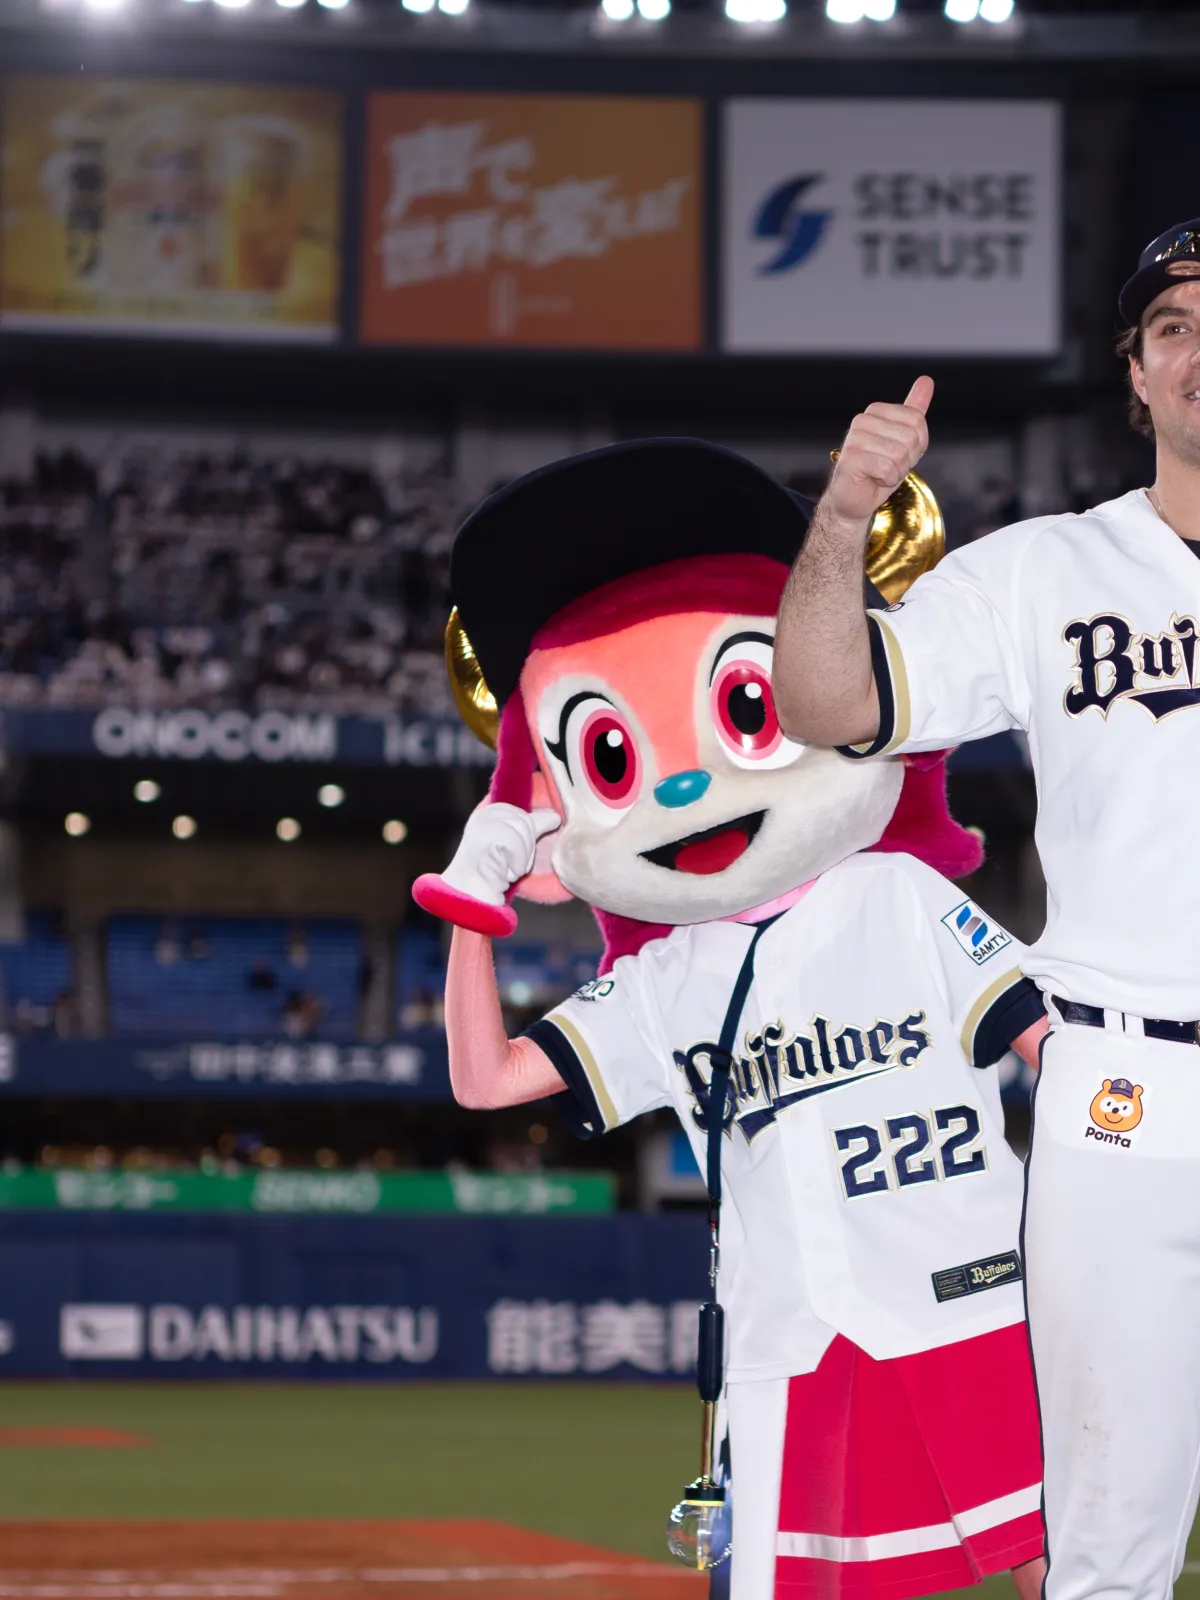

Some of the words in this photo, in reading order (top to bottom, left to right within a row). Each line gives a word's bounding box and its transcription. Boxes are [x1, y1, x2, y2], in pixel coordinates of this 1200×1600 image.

[854, 173, 1036, 220] SENSE
[854, 230, 1031, 282] TRUST
[93, 709, 338, 759] ONOCOM
[972, 931, 1007, 961] SAMTY
[830, 1102, 989, 1203] 222
[1085, 1126, 1131, 1148] Ponta
[970, 1261, 1016, 1285] Buffaloes
[151, 1308, 438, 1363] DAIHATSU
